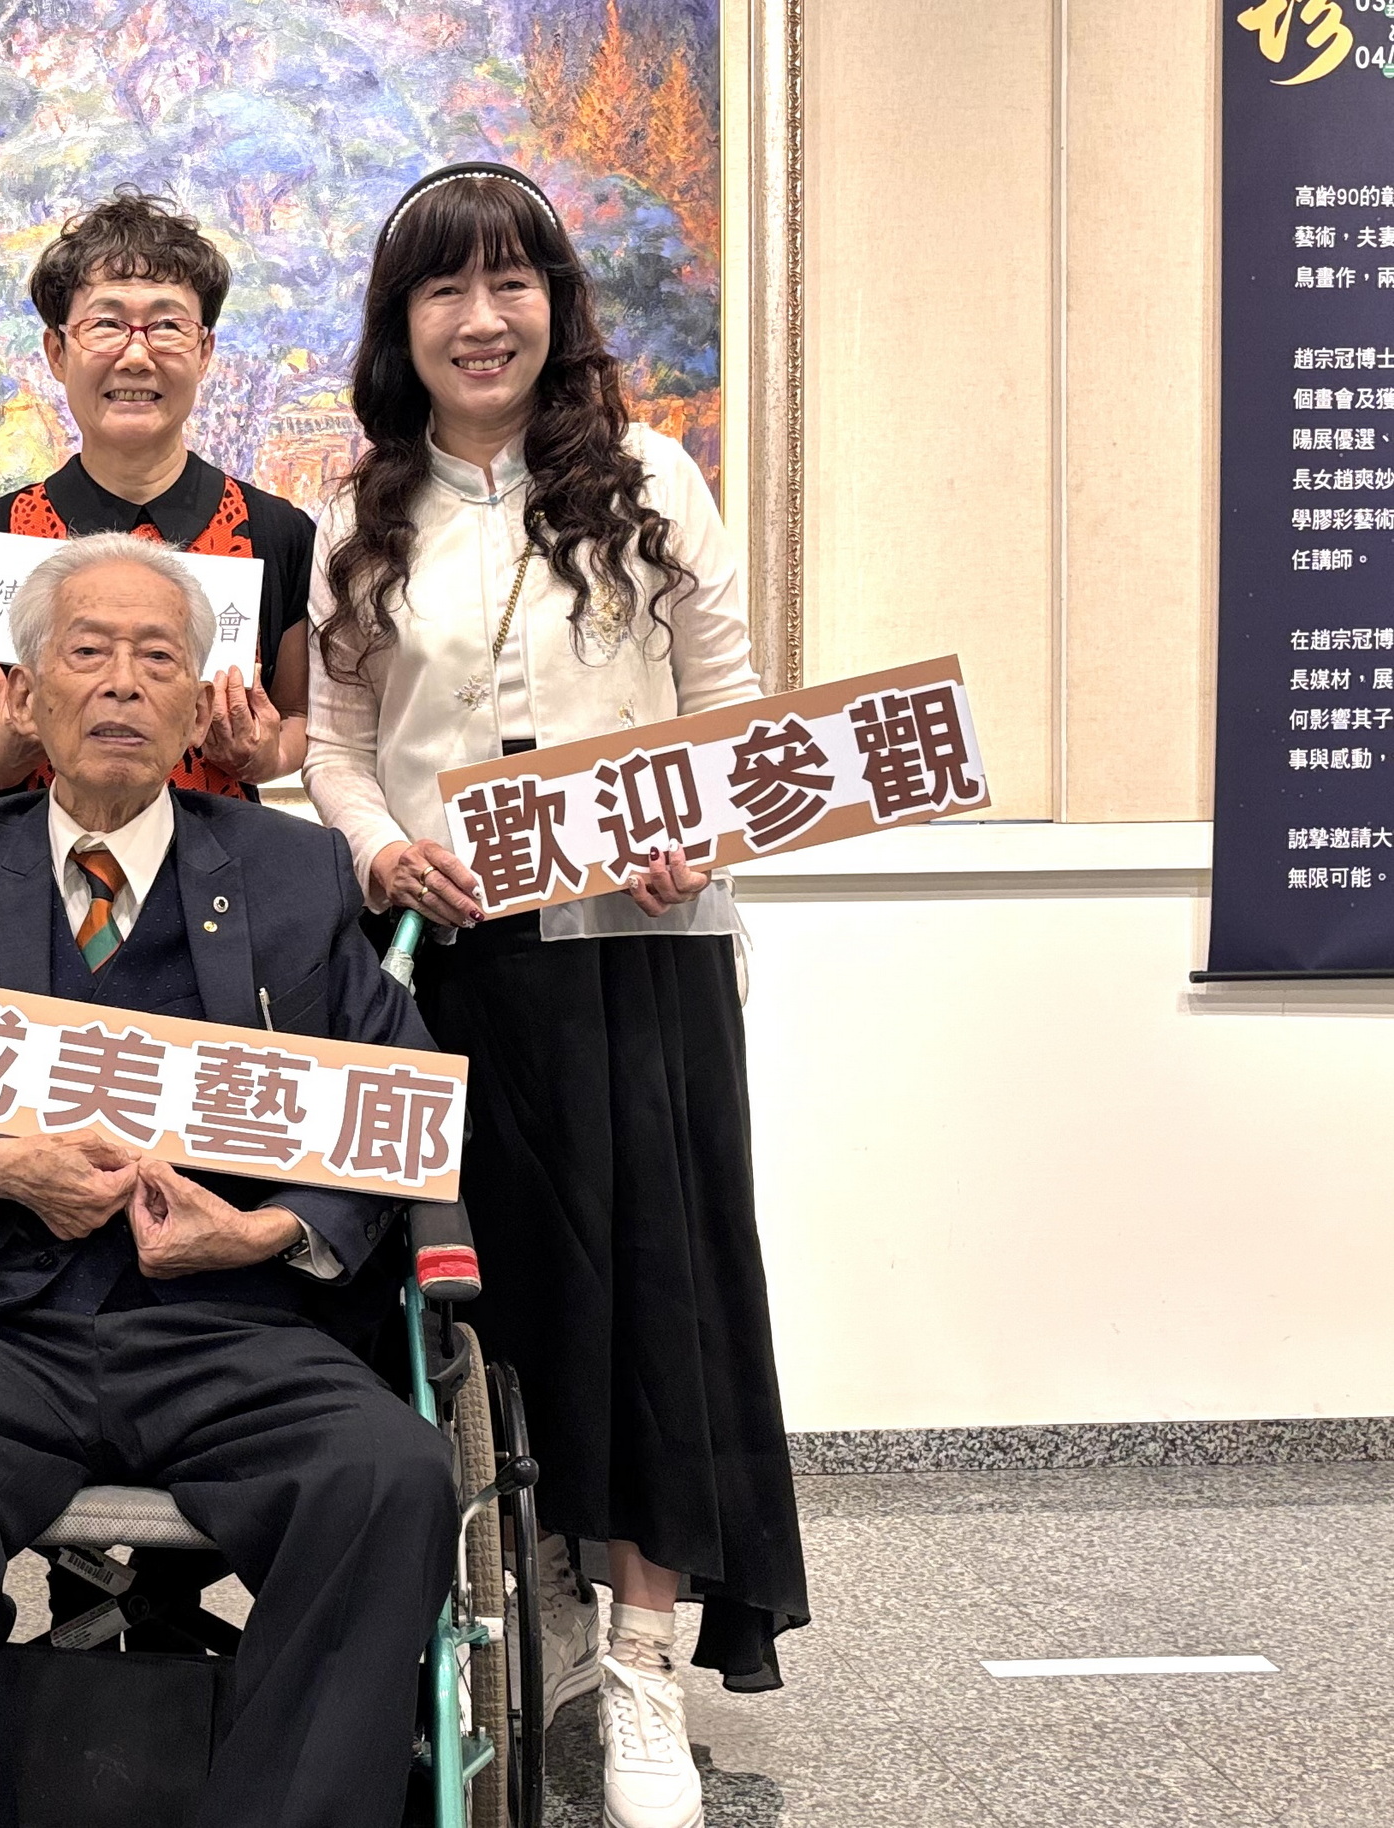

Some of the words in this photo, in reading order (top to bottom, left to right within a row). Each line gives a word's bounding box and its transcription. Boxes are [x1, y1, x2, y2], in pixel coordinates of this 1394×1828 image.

[1293, 346, 1394, 369] 趙宗冠博士
[1292, 467, 1394, 490] 長女趙爽妙
[1291, 508, 1394, 530] 學膠彩藝術
[1290, 628, 1394, 650] 在趙宗冠博
[1289, 707, 1394, 730] 何影響其子
[456, 685, 980, 908] 歡迎參觀
